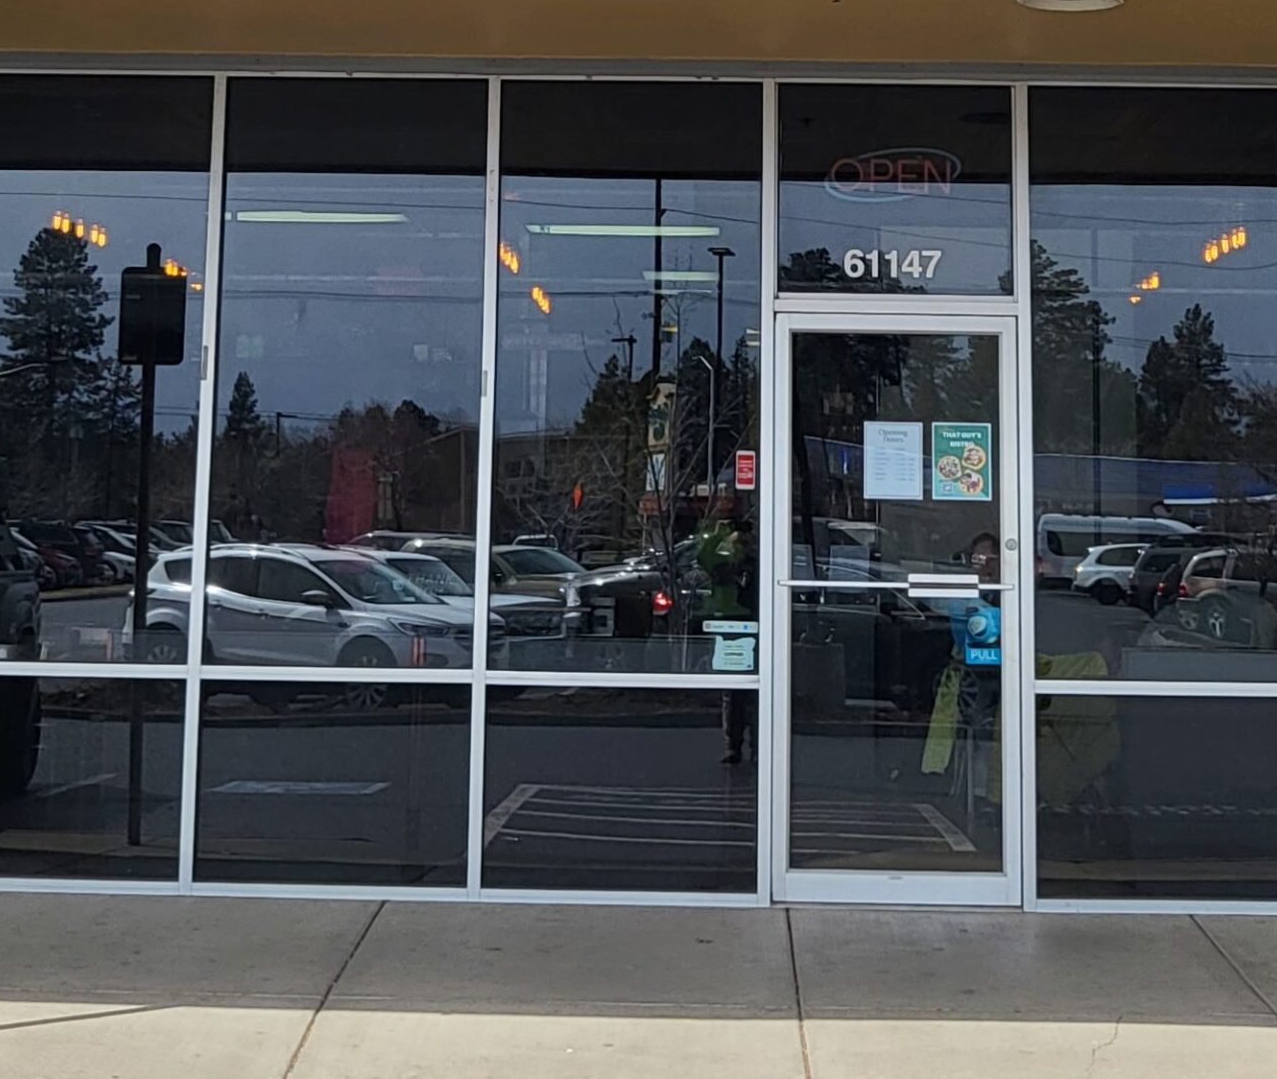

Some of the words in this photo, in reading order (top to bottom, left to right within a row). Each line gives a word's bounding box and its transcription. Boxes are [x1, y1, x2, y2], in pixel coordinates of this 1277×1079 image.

[831, 157, 952, 195] OPEN
[843, 248, 942, 279] 61147
[970, 648, 998, 661] PULL
